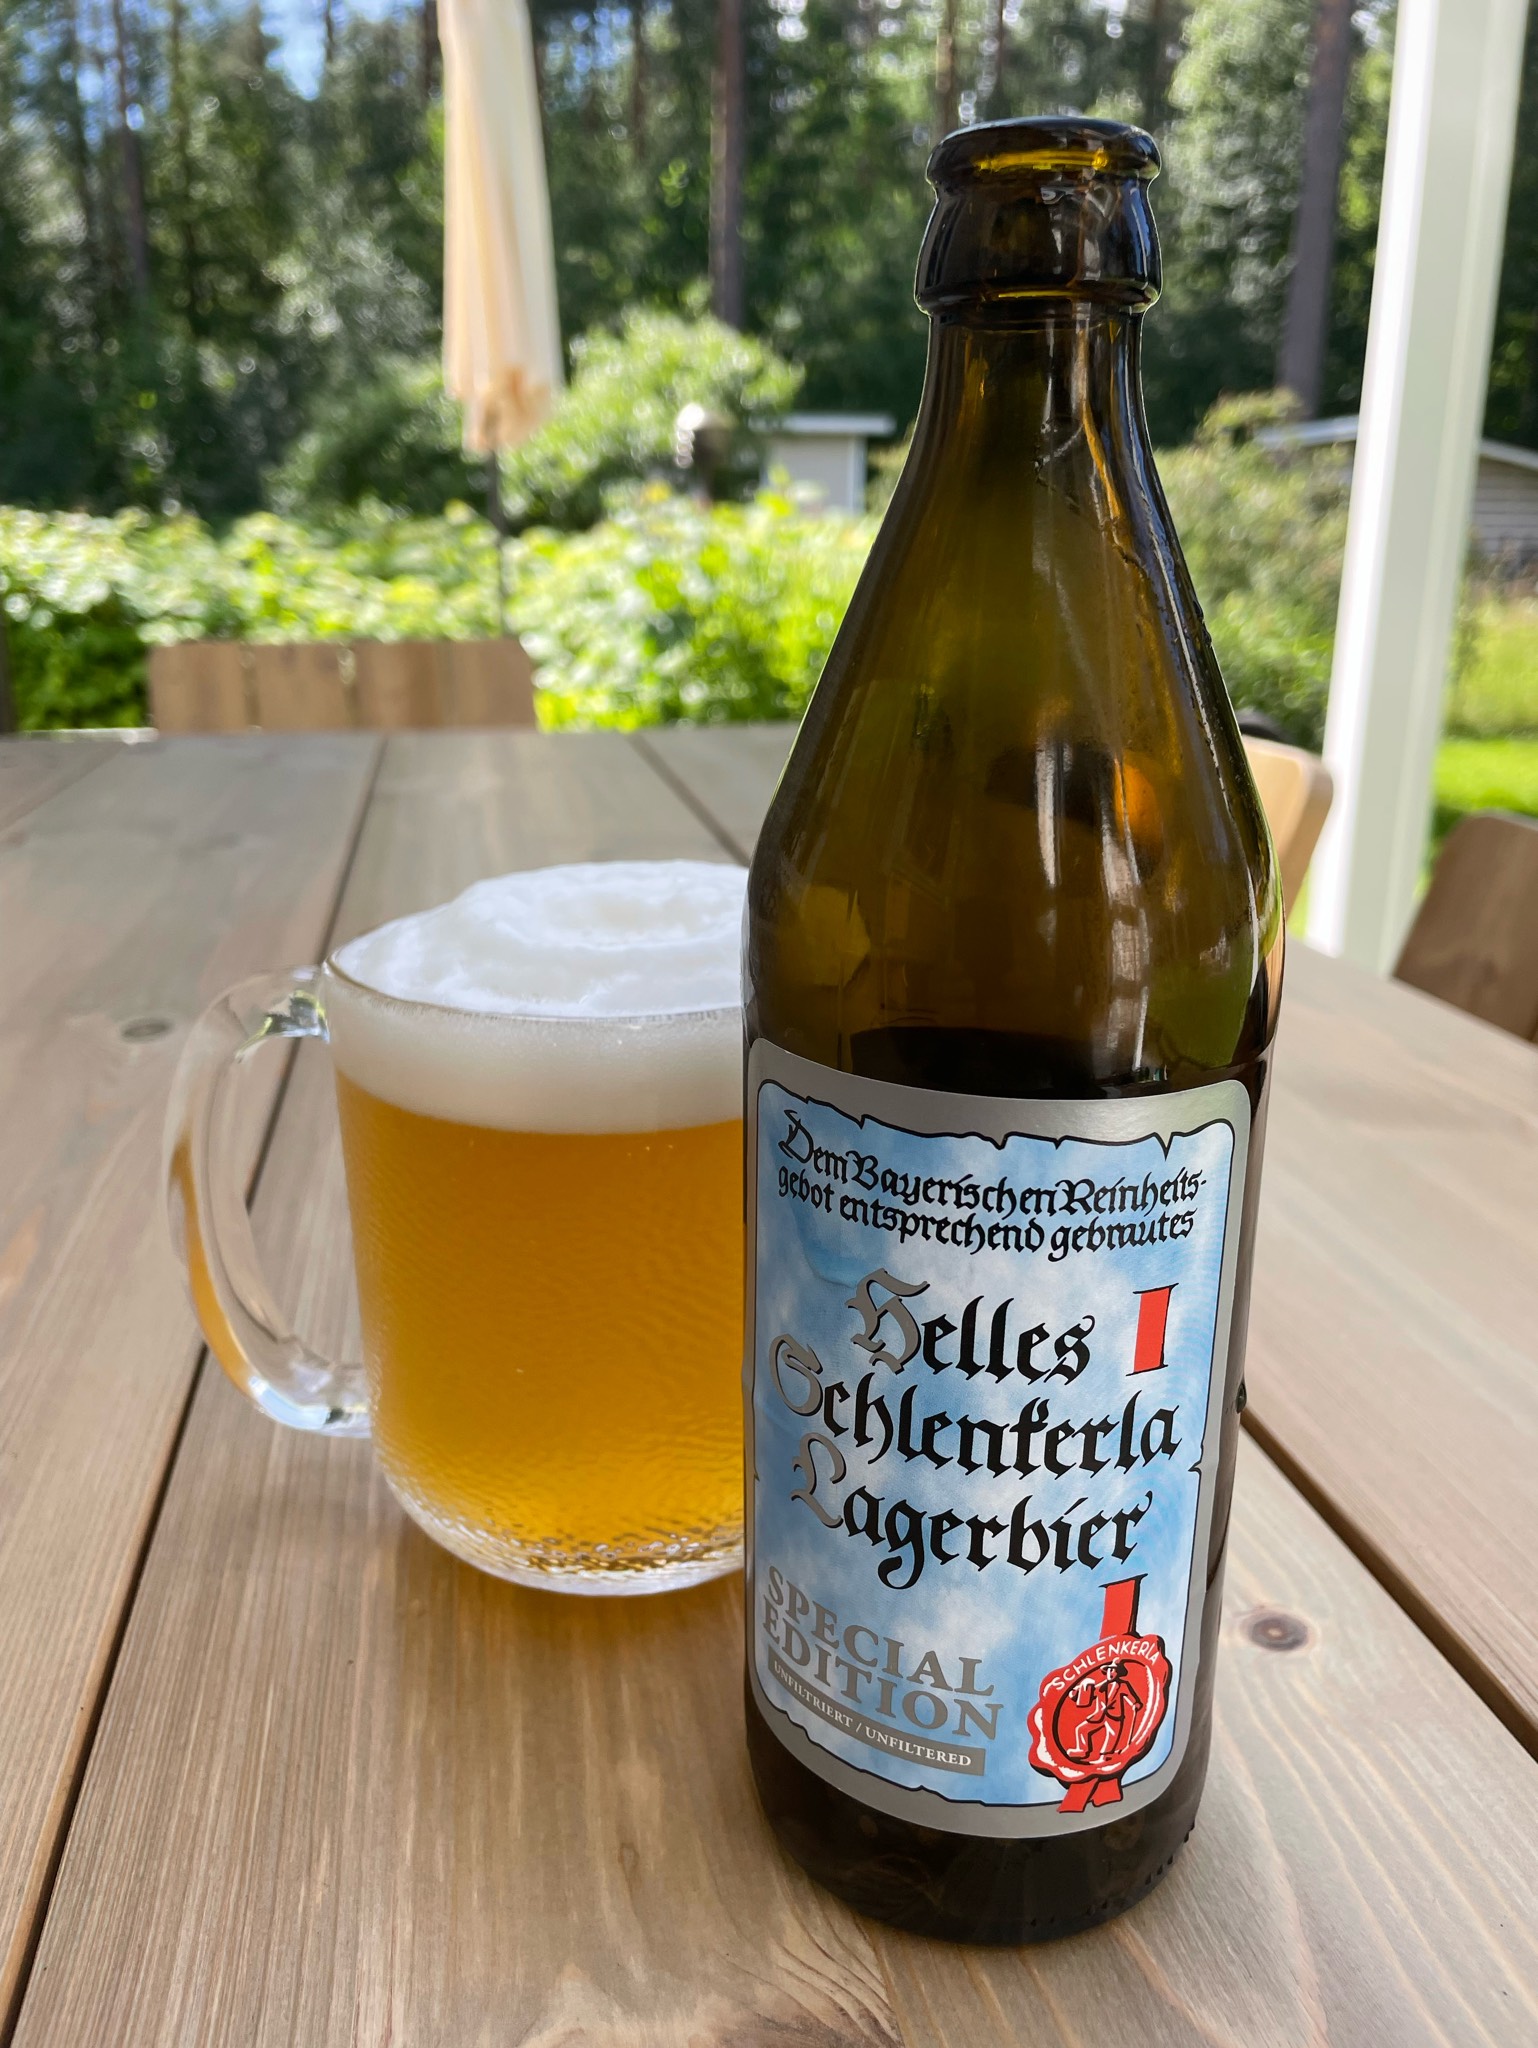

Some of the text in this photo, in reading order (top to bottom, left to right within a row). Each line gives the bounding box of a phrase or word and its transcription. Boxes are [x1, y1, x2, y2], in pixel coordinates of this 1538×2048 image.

[777, 1164, 1198, 1262] gebot entsprechend gebrautes
[778, 1109, 849, 1185] Dem
[846, 1151, 1058, 1219] Bayerischen
[845, 1267, 1096, 1386] Helles
[768, 1333, 1183, 1479] Schlenkerla
[790, 1432, 1154, 1590] Lagerbier
[762, 1602, 1005, 1740] EDITION
[764, 1565, 996, 1697] SPECIAL
[1051, 1640, 1160, 1692] SCHLENKERLA
[772, 1661, 853, 1729] UNFILTRIERT
[864, 1727, 973, 1768] UNFILTERED
